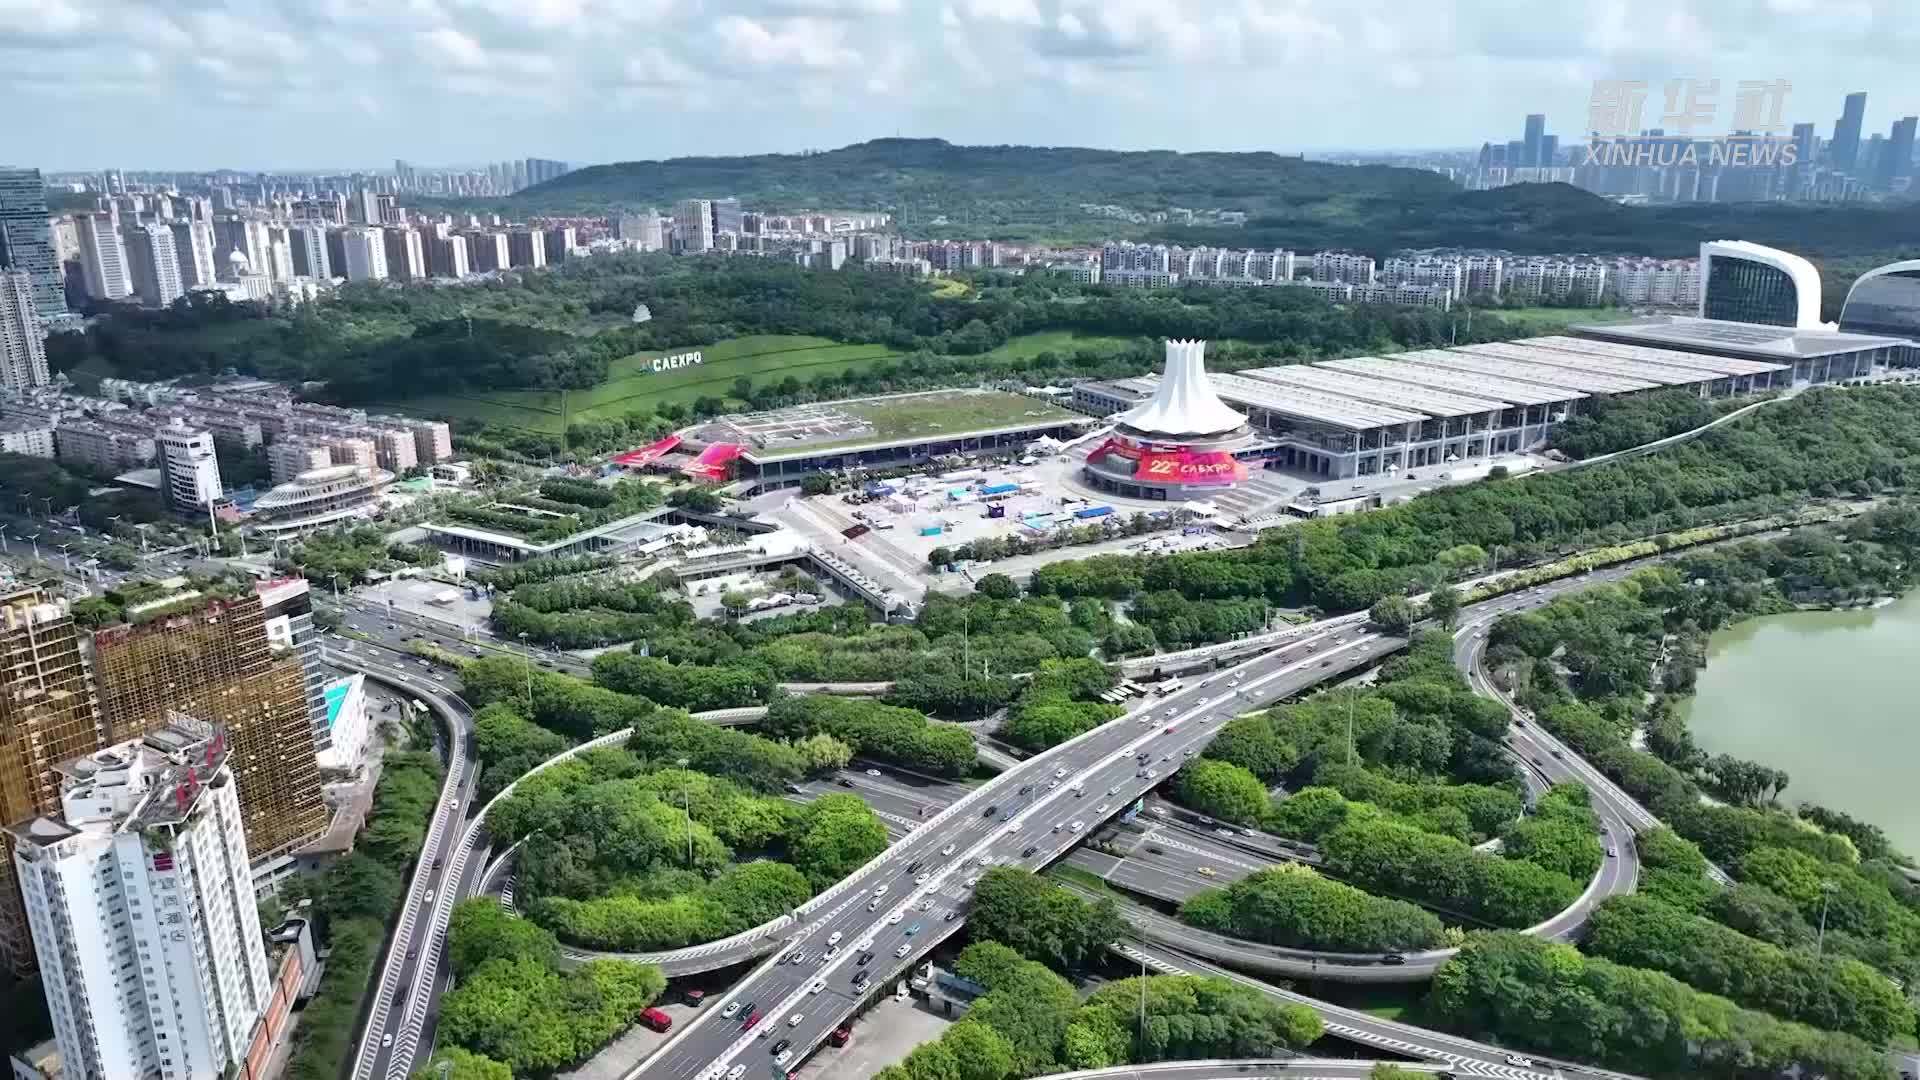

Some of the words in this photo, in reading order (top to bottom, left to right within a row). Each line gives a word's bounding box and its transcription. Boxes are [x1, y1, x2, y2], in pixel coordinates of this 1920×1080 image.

[653, 351, 702, 372] CAEXPO
[1149, 460, 1179, 474] 22
[1181, 463, 1231, 475] CAEXPO
